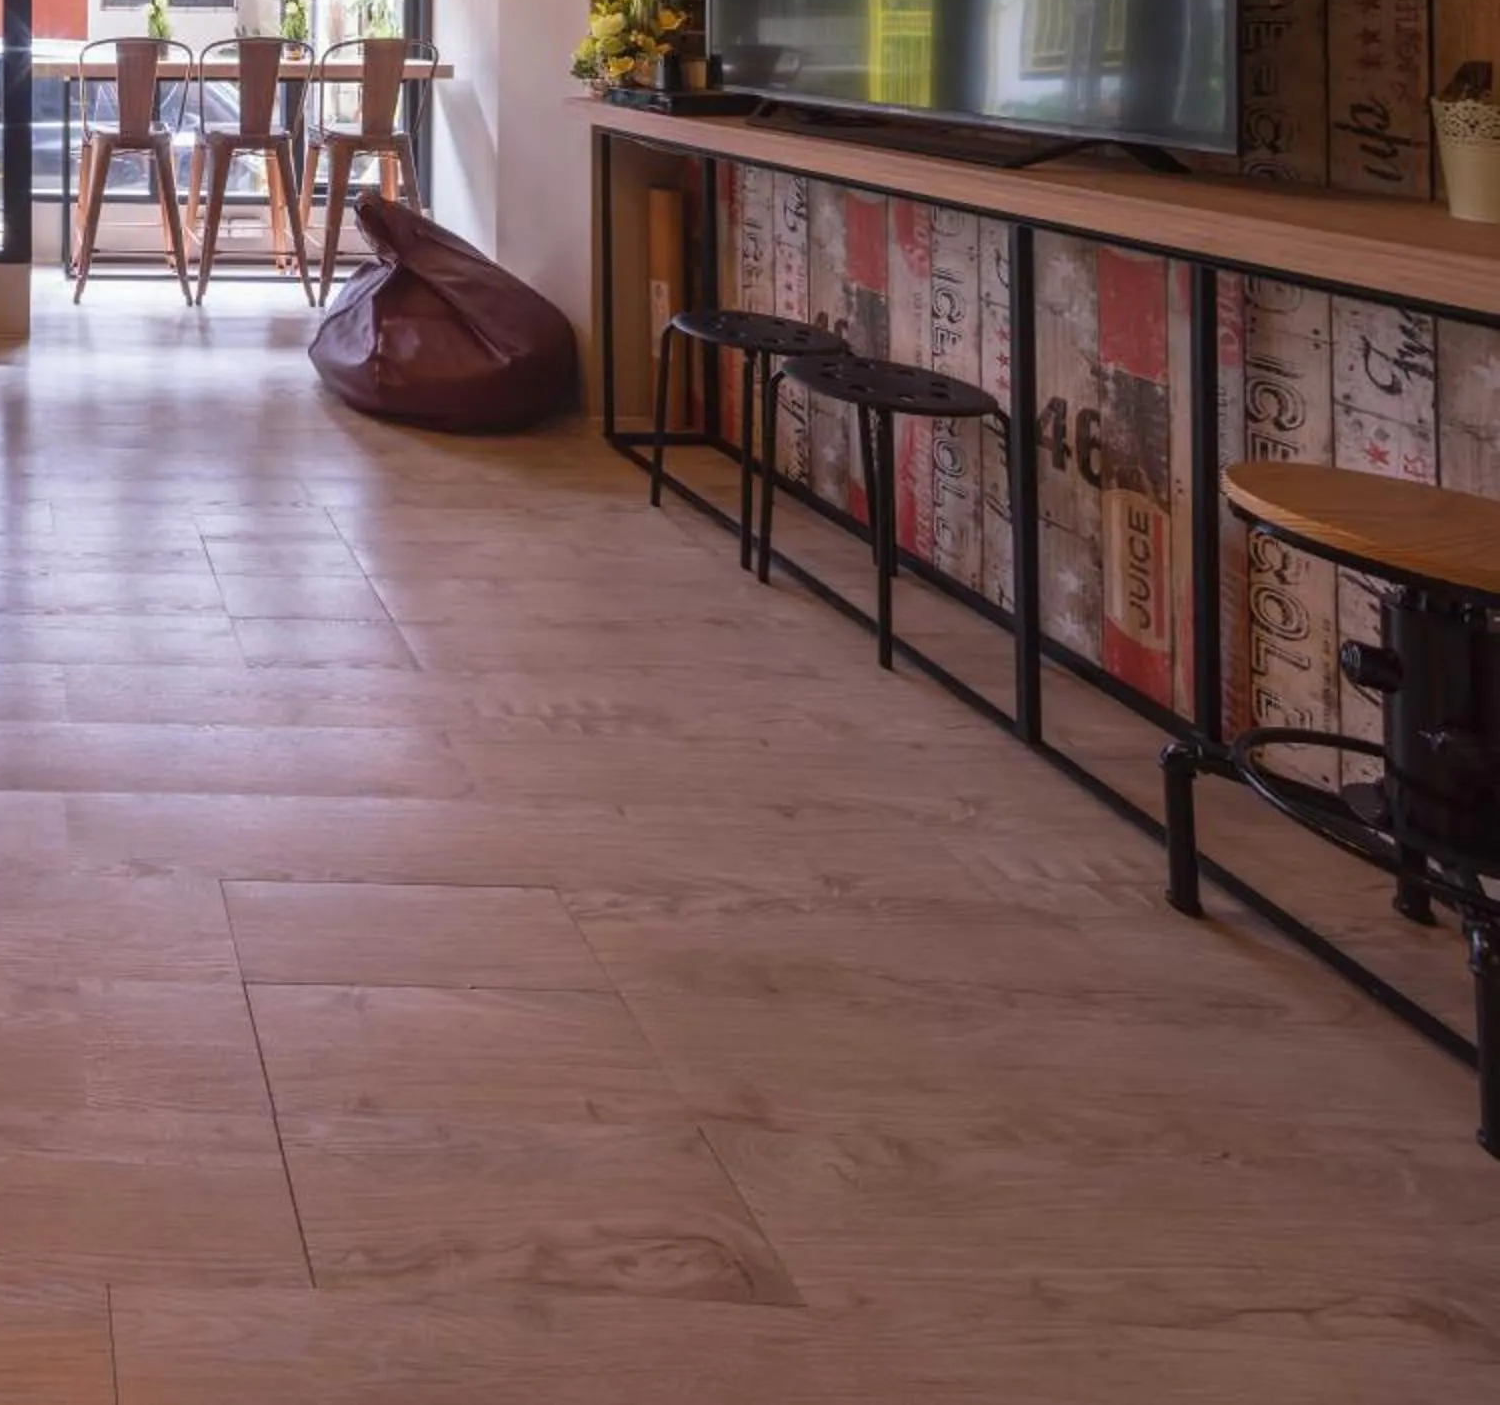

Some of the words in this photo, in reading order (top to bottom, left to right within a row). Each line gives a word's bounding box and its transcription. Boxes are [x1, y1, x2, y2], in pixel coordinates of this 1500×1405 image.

[1333, 98, 1422, 183] up
[1036, 396, 1102, 490] 46
[1127, 504, 1151, 631] JUICE
